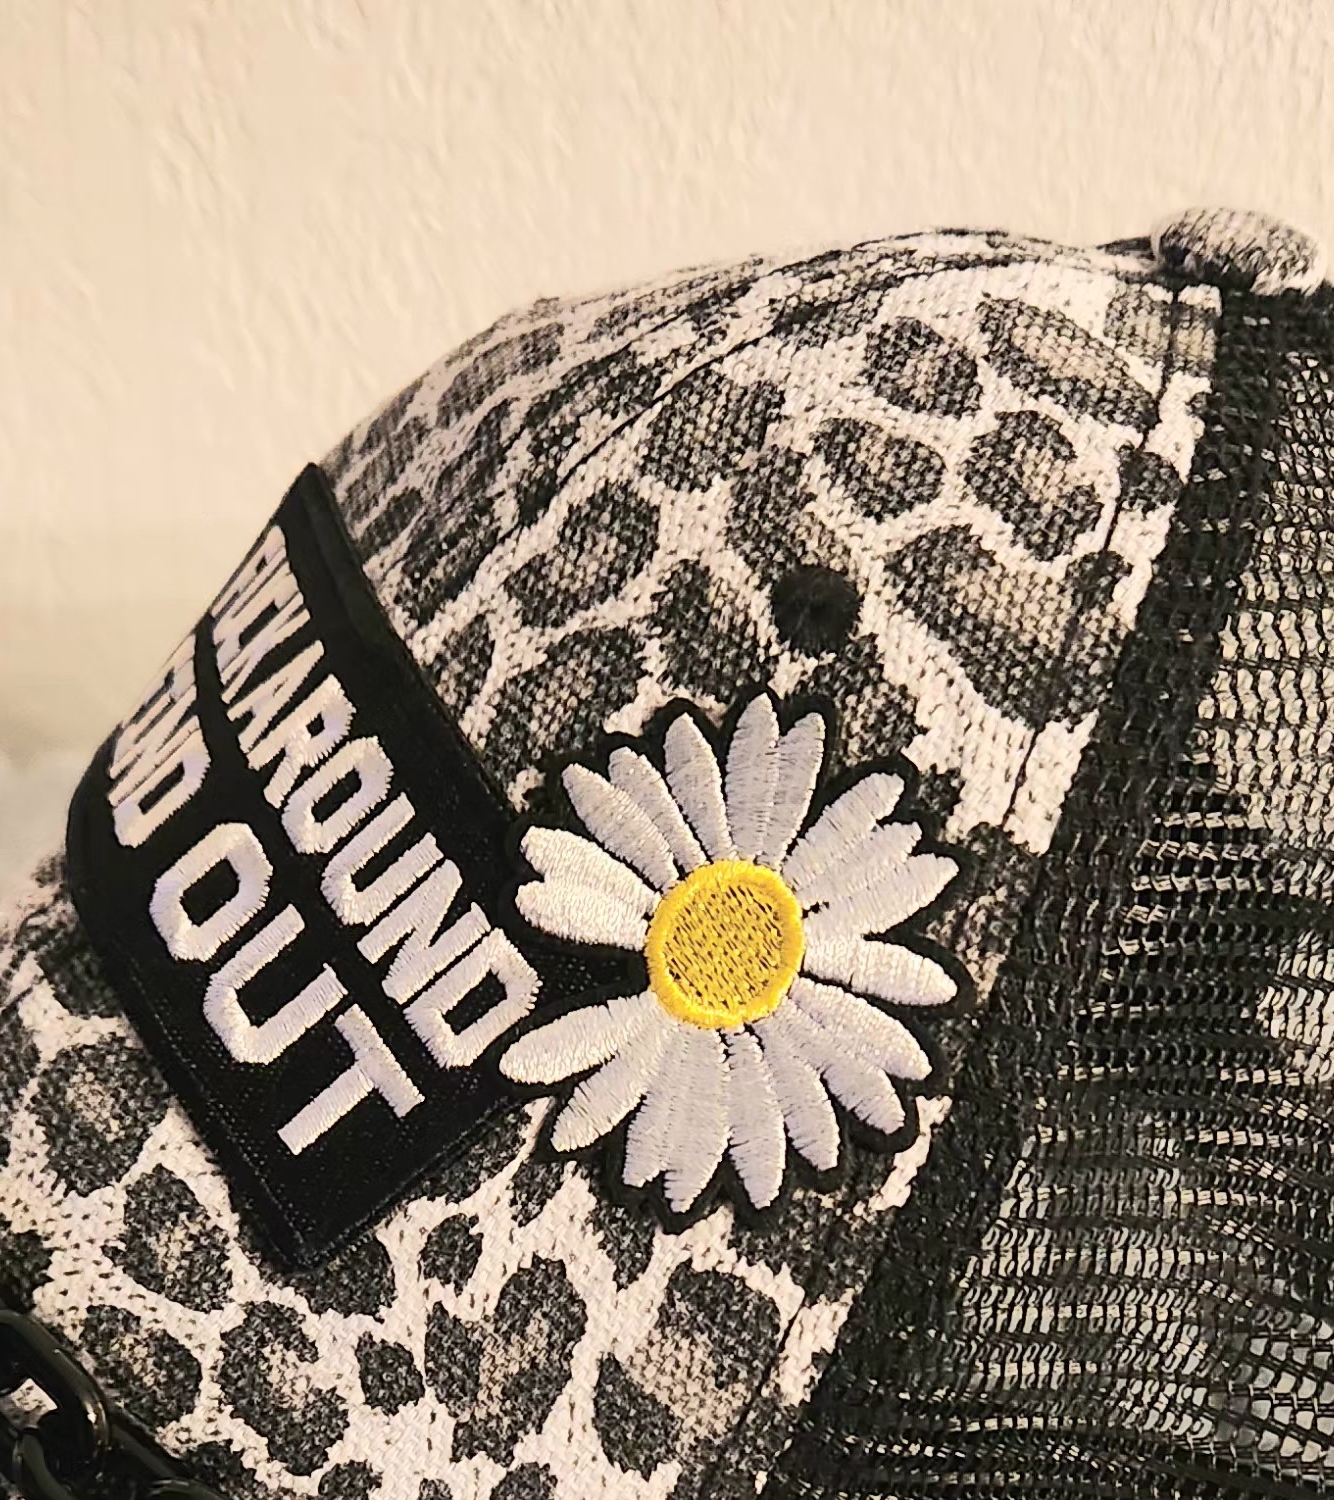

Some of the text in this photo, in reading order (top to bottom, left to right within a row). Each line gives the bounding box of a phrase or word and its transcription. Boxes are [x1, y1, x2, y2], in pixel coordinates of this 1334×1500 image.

[149, 821, 425, 1156] OUT
[209, 524, 543, 1070] FUCK AROUND
